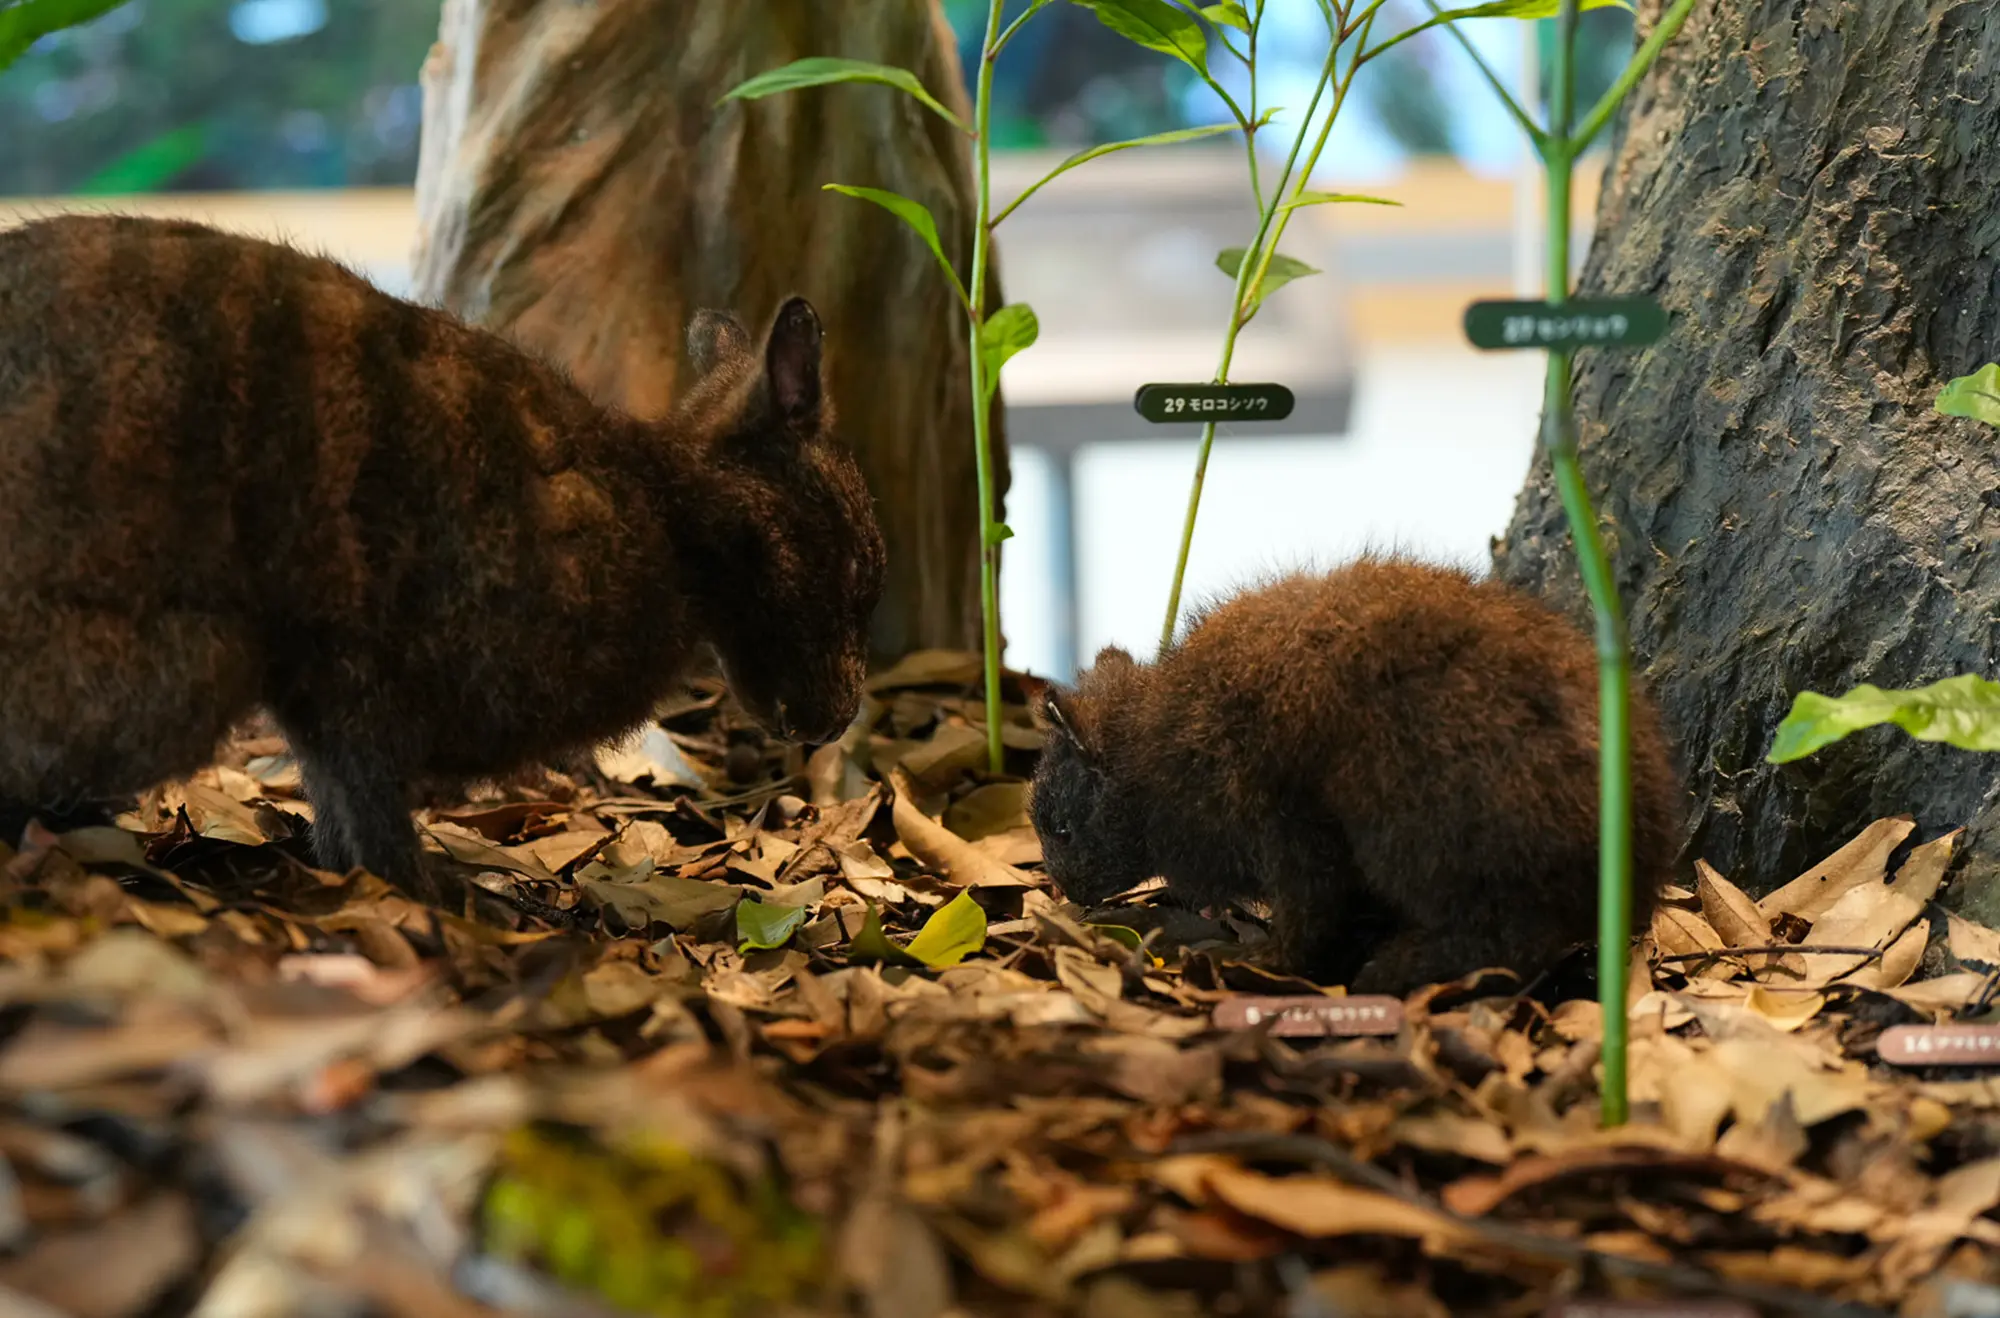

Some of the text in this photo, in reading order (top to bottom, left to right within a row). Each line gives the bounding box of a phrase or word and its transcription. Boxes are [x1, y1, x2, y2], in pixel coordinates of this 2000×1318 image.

[1165, 397, 1269, 413] 29 モロコシソウ
